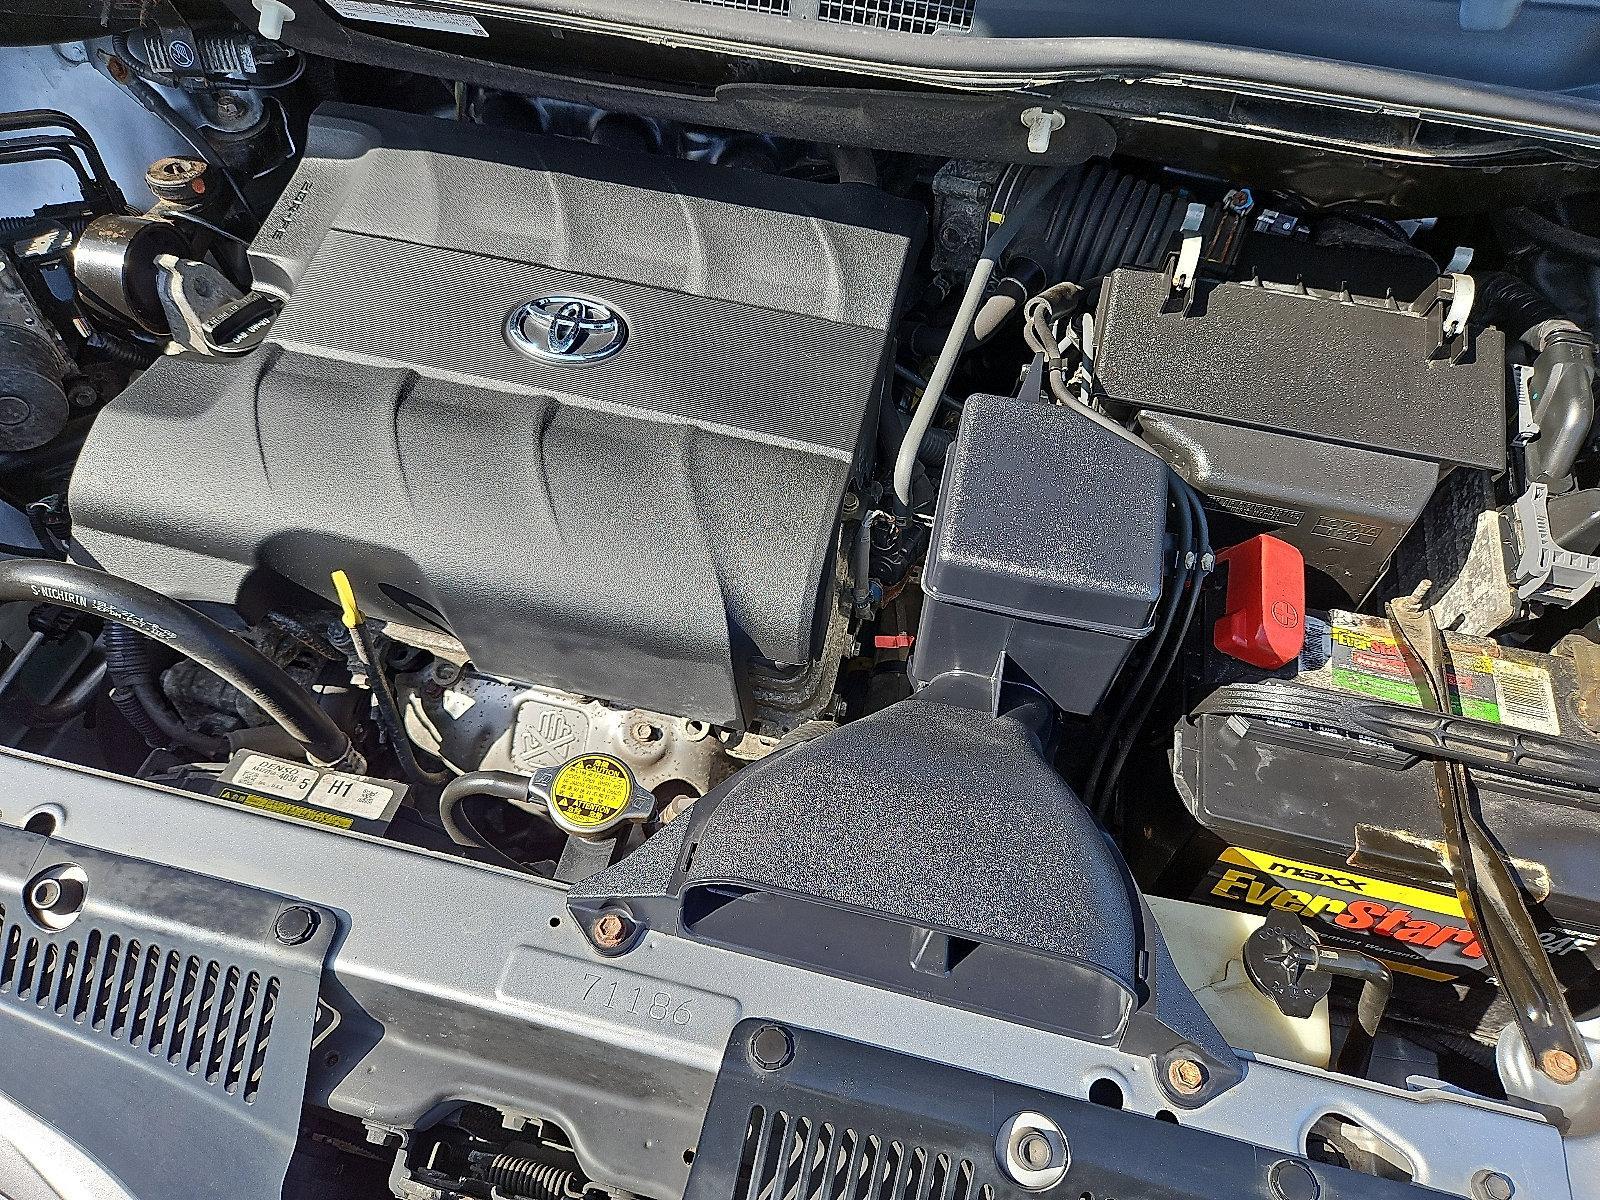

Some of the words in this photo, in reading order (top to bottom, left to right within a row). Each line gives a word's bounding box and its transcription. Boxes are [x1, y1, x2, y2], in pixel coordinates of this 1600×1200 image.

[258, 761, 299, 775] DENSO
[585, 764, 620, 778] CAUTION
[298, 778, 311, 790] 5
[326, 779, 354, 798] H1
[572, 799, 611, 815] ATTENTION
[1267, 861, 1368, 892] maxx
[582, 972, 694, 1026] 71186
